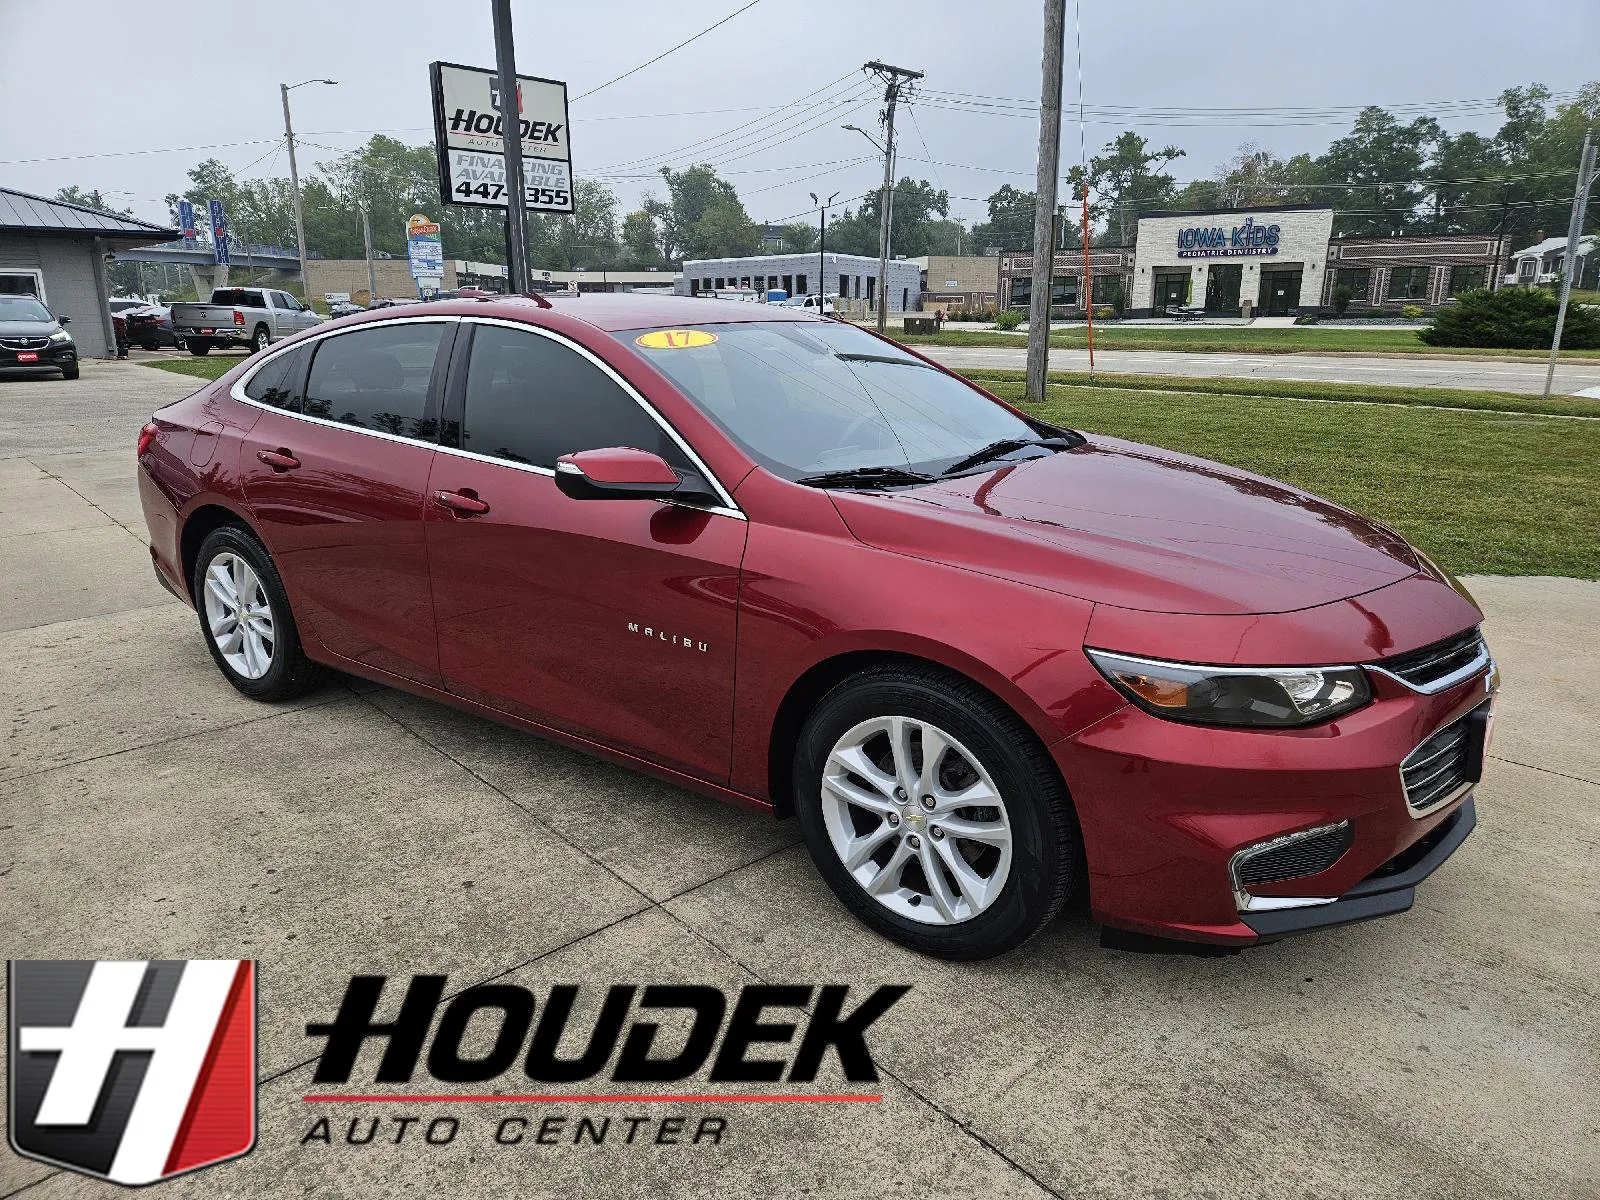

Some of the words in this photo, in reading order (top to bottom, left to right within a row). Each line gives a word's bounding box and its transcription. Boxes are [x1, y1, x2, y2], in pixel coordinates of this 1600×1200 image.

[467, 138, 499, 148] AUTO
[456, 154, 563, 176] FINACING
[456, 168, 565, 189] AVAIBLE
[455, 181, 569, 206] 447-355
[1177, 227, 1226, 248] IOWA
[1182, 249, 1225, 257] PEDIATRIC
[1227, 247, 1273, 256] DENTISTRY
[664, 331, 690, 347] 17
[627, 622, 708, 653] MALIBU
